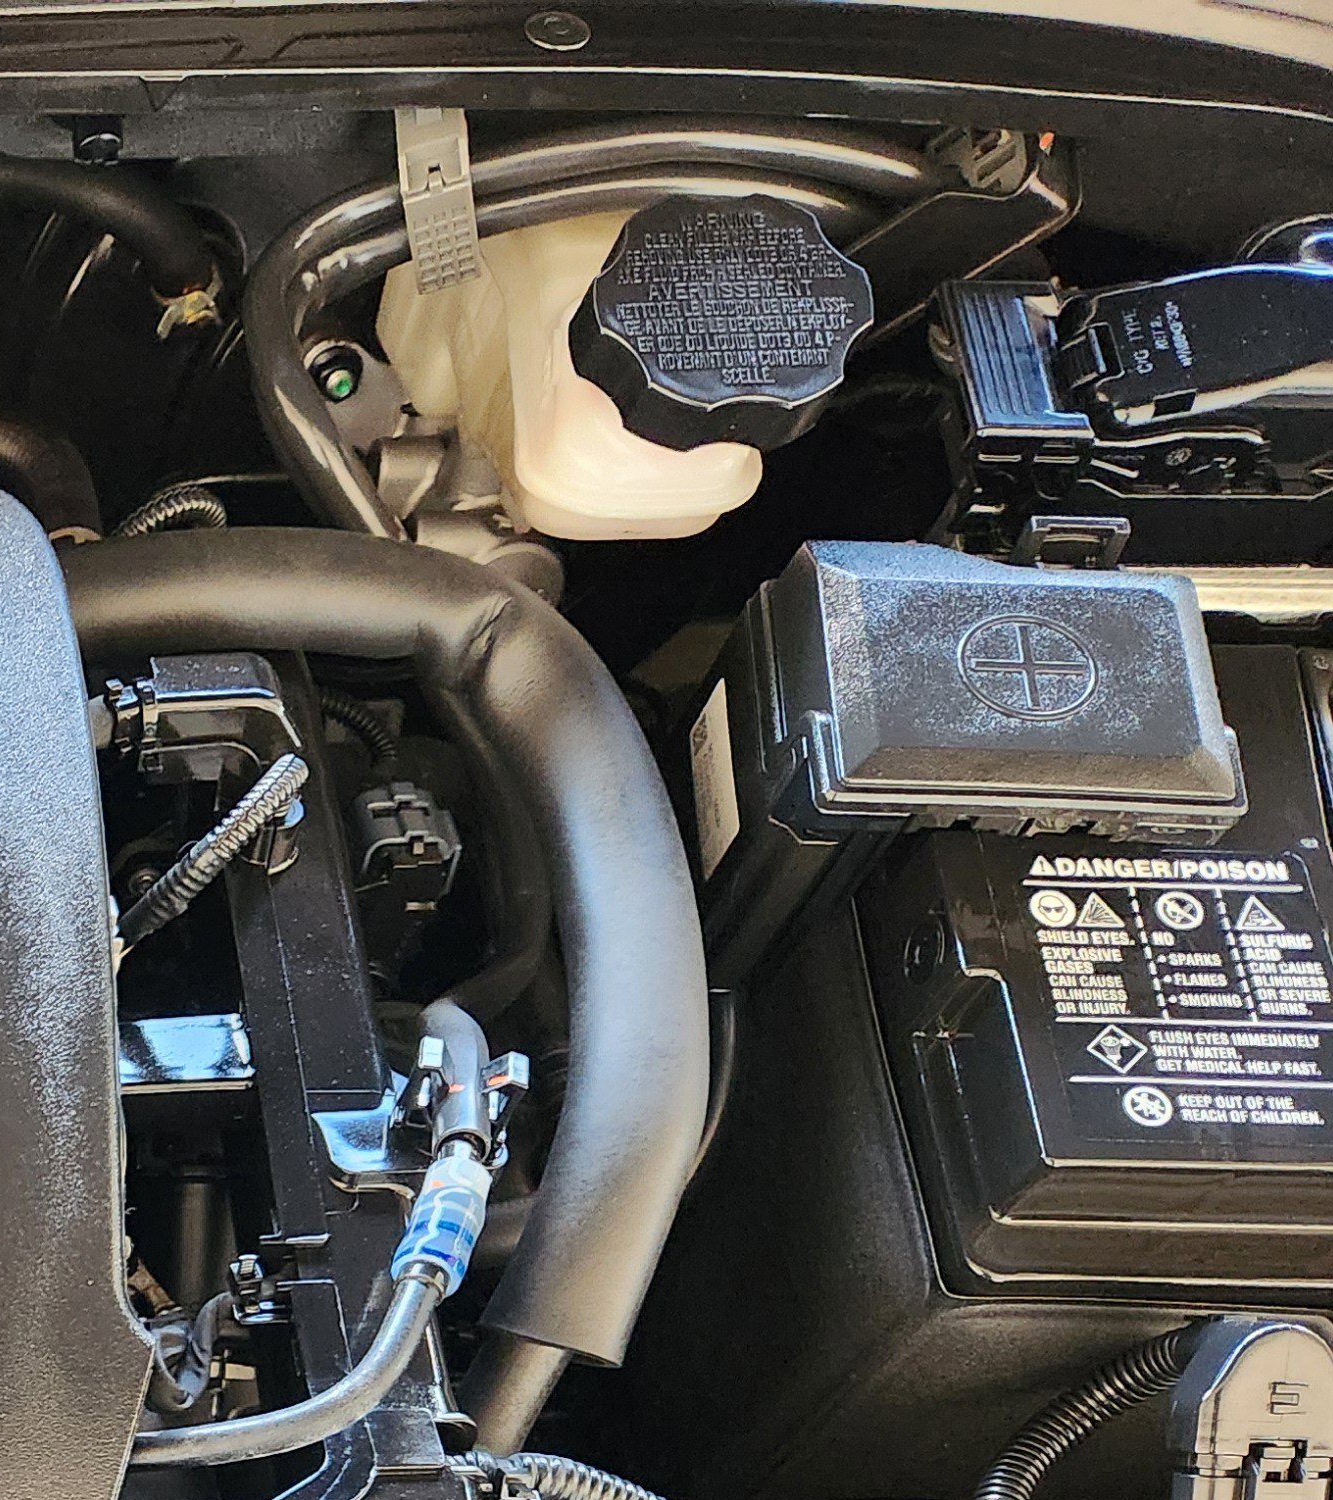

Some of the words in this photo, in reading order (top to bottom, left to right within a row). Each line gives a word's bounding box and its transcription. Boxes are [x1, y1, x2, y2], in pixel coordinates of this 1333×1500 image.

[648, 279, 813, 301] AVERTISSEMENT
[616, 302, 682, 320] NETTOYER
[684, 300, 701, 317] LE
[763, 298, 780, 314] DE
[1055, 856, 1290, 882] DANGER/POISON
[1035, 929, 1090, 945] SHIELD
[1090, 930, 1136, 946] EYES.
[1151, 930, 1176, 947] NO
[1238, 932, 1314, 950] SULFURIC
[1040, 946, 1124, 962] EXPLOSIVE
[1168, 952, 1223, 968] SPARKS
[1243, 947, 1284, 962] ACID
[1044, 960, 1095, 975] GASES
[1248, 961, 1277, 975] CAN
[1278, 961, 1326, 976] CAUSE
[1048, 974, 1077, 988] CAN
[1079, 975, 1124, 989] CAUSE
[1173, 972, 1229, 988] FLAMES
[1251, 974, 1330, 989] BLINDNESS
[1051, 988, 1129, 1002] BLINDNESS
[1178, 992, 1244, 1009] SMOKING
[1255, 988, 1278, 1002] OR
[1278, 988, 1332, 1004] SEVERE
[1055, 1001, 1077, 1014] OR
[1078, 1001, 1131, 1016] INJURY.
[1258, 1002, 1314, 1017] BURNS.
[1148, 1029, 1194, 1045] FLUSH
[1194, 1030, 1230, 1046] EYES
[1231, 1032, 1321, 1049] IMMEDIATELY
[1152, 1044, 1190, 1059] WITH
[1191, 1045, 1243, 1061] WATER.
[1155, 1058, 1183, 1073] GET
[1185, 1059, 1245, 1075] MEDICAL
[1246, 1060, 1282, 1075] HELP
[1284, 1061, 1323, 1077] FAST.
[1177, 1094, 1213, 1109] KEEP
[1214, 1094, 1243, 1110] OUT
[1244, 1095, 1265, 1110] OF
[1265, 1095, 1295, 1111] THE
[1181, 1108, 1229, 1124] REACH
[1229, 1109, 1249, 1124] OF
[1250, 1110, 1326, 1126] CHILDREN.
